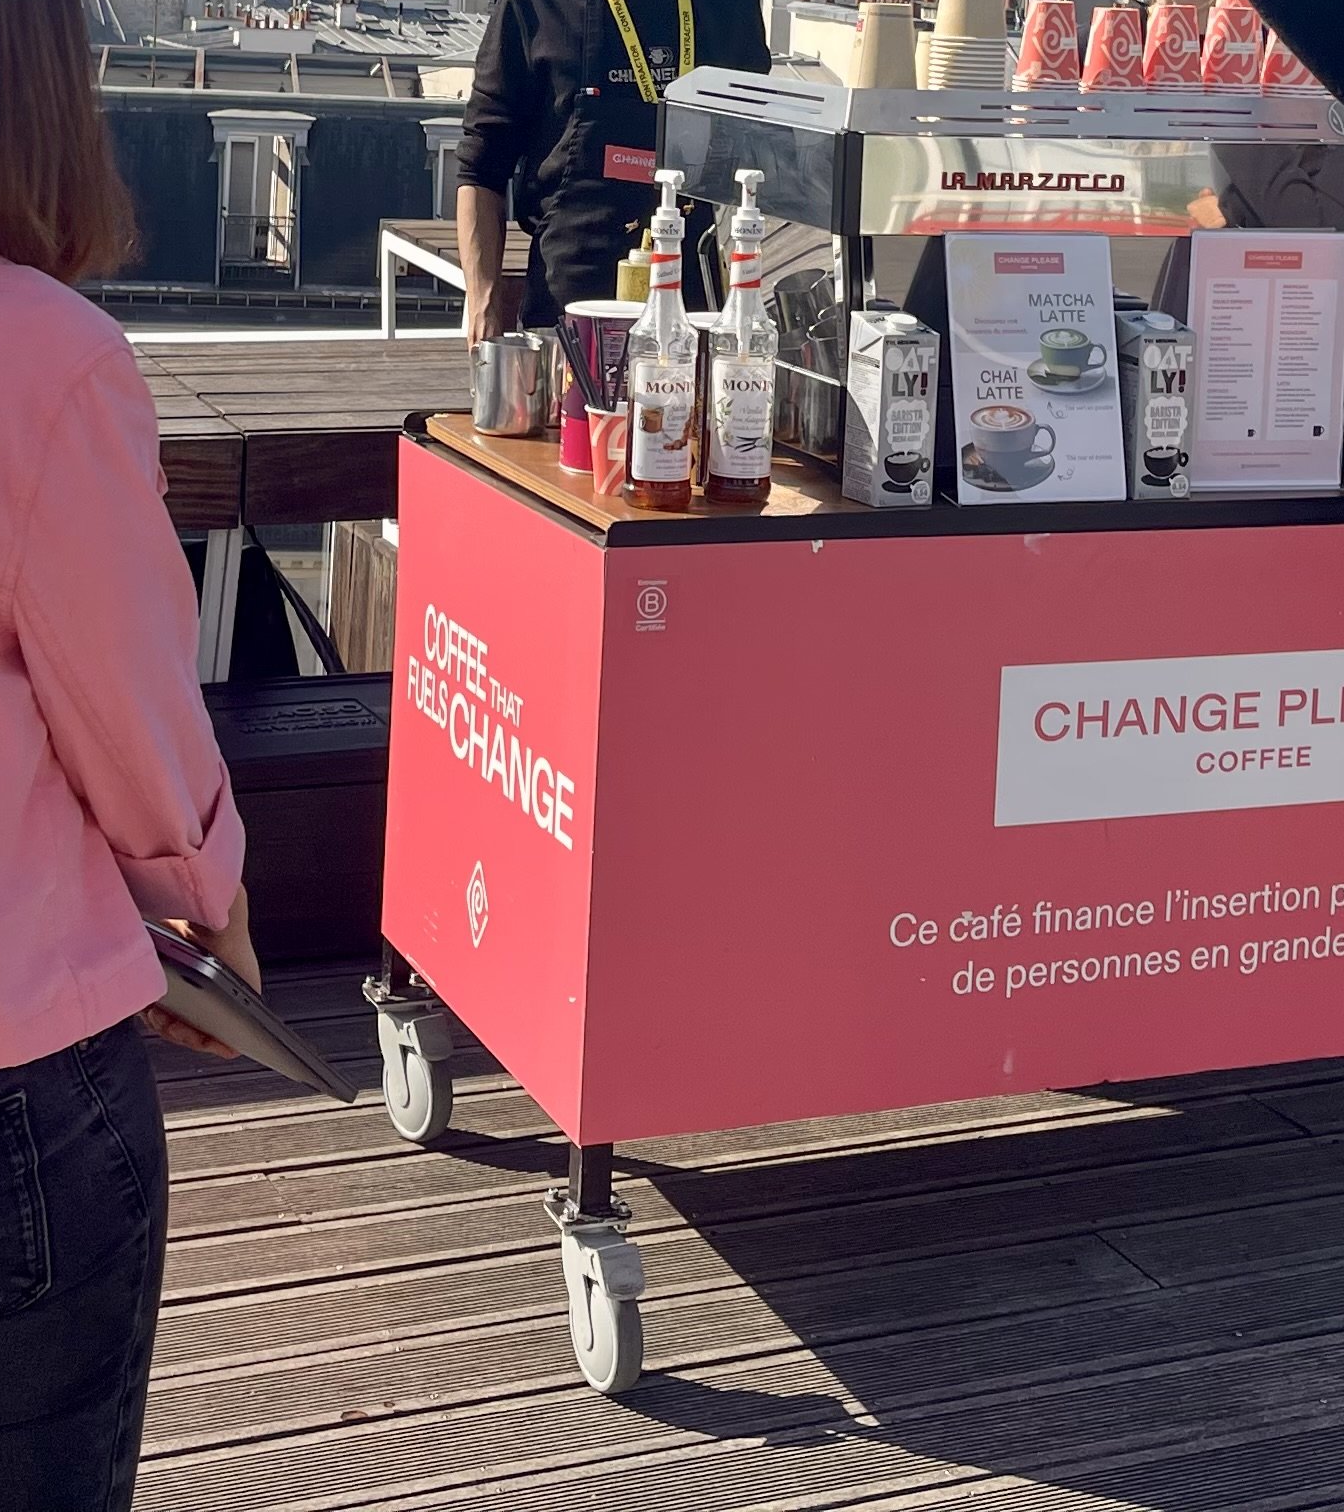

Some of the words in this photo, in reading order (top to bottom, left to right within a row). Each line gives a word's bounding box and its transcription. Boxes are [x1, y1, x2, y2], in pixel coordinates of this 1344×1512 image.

[682, 10, 691, 66] CONTRACTOR
[1028, 293, 1095, 307] MATCHA
[1039, 309, 1086, 323] LATTE
[892, 372, 928, 397] LY!
[980, 366, 1018, 384] CHAÏ
[1150, 369, 1187, 394] LY!
[976, 386, 1024, 400] LATTE
[891, 409, 923, 422] BARISTA
[892, 422, 922, 434] EDITION
[645, 593, 660, 612] B
[424, 603, 488, 702] COFFEE
[488, 676, 524, 728] THAT
[1033, 691, 1261, 742] CHANGE
[407, 655, 449, 729] FUELS
[449, 692, 575, 852] CHANGE
[1196, 745, 1312, 774] COFFEE
[889, 912, 939, 947] Ce
[949, 903, 1022, 943] café
[1032, 900, 1155, 935] finance
[1164, 881, 1320, 922] l'insertion
[952, 960, 995, 995] de
[1006, 948, 1181, 999] personnes
[1190, 943, 1229, 971] en
